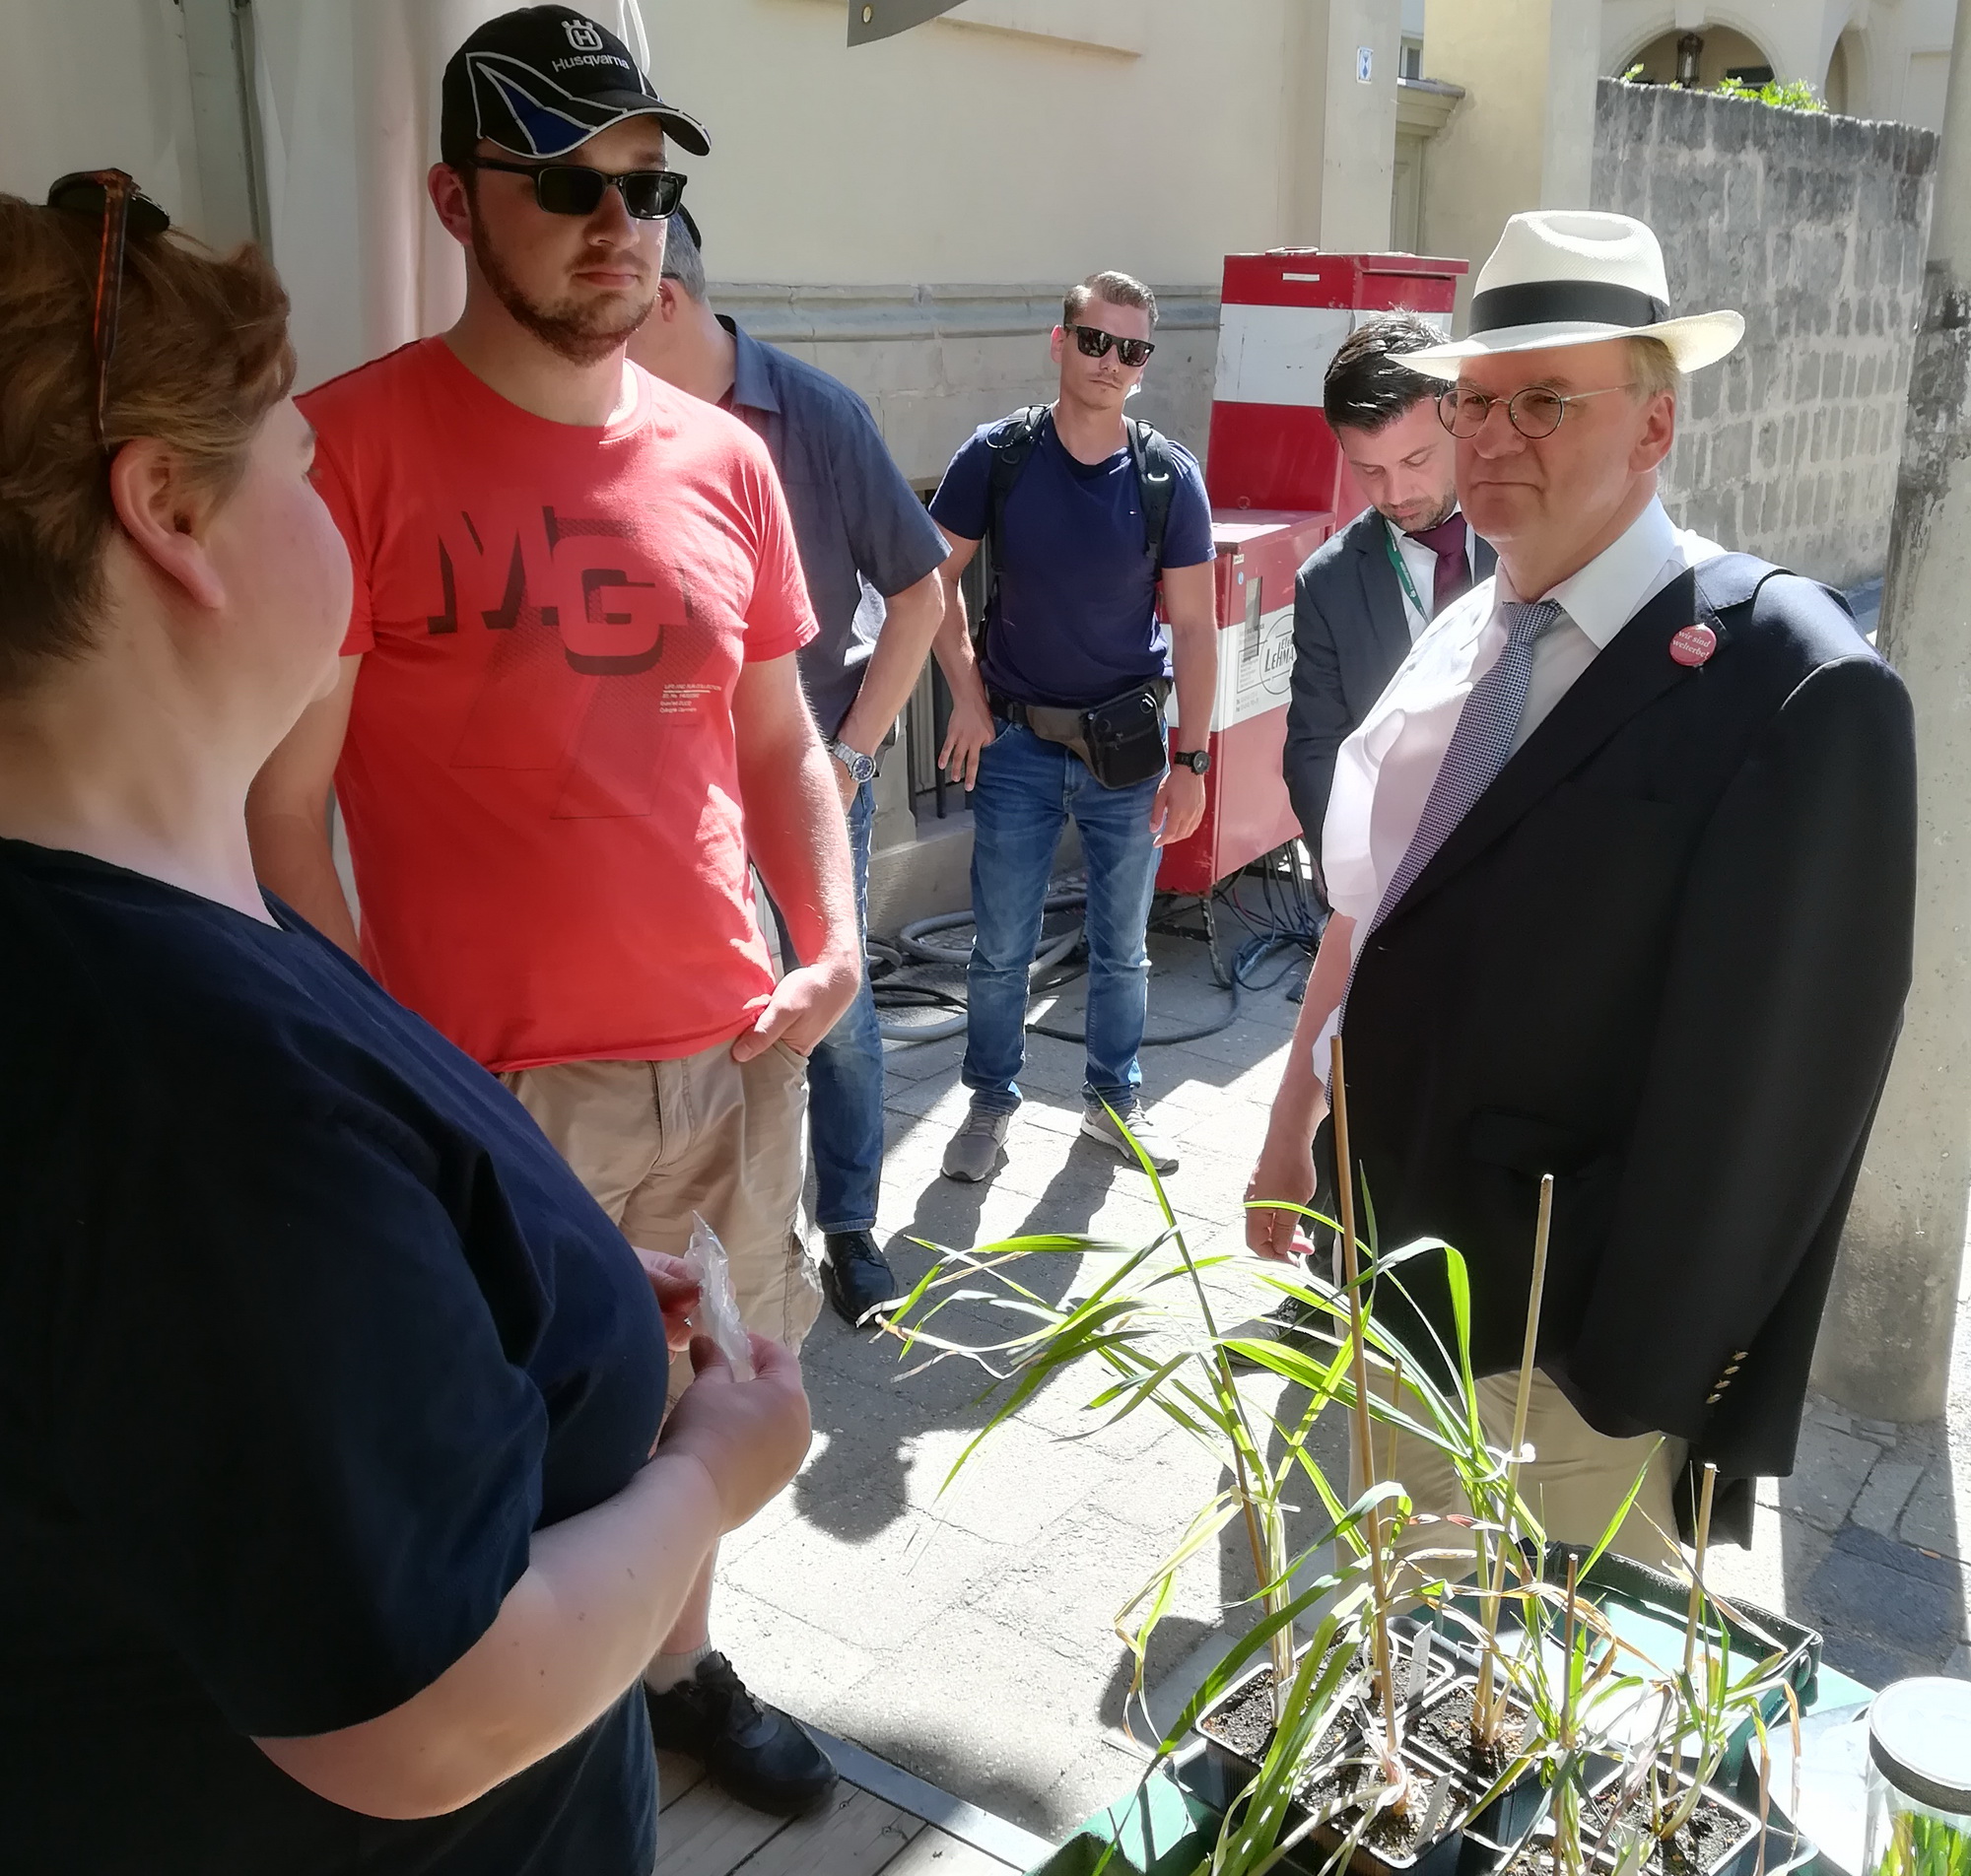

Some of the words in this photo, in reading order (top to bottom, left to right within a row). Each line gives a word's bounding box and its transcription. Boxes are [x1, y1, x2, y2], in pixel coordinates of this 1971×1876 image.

[552, 54, 631, 73] Husqvarna
[1678, 631, 1692, 640] wir
[1692, 636, 1711, 647] sind
